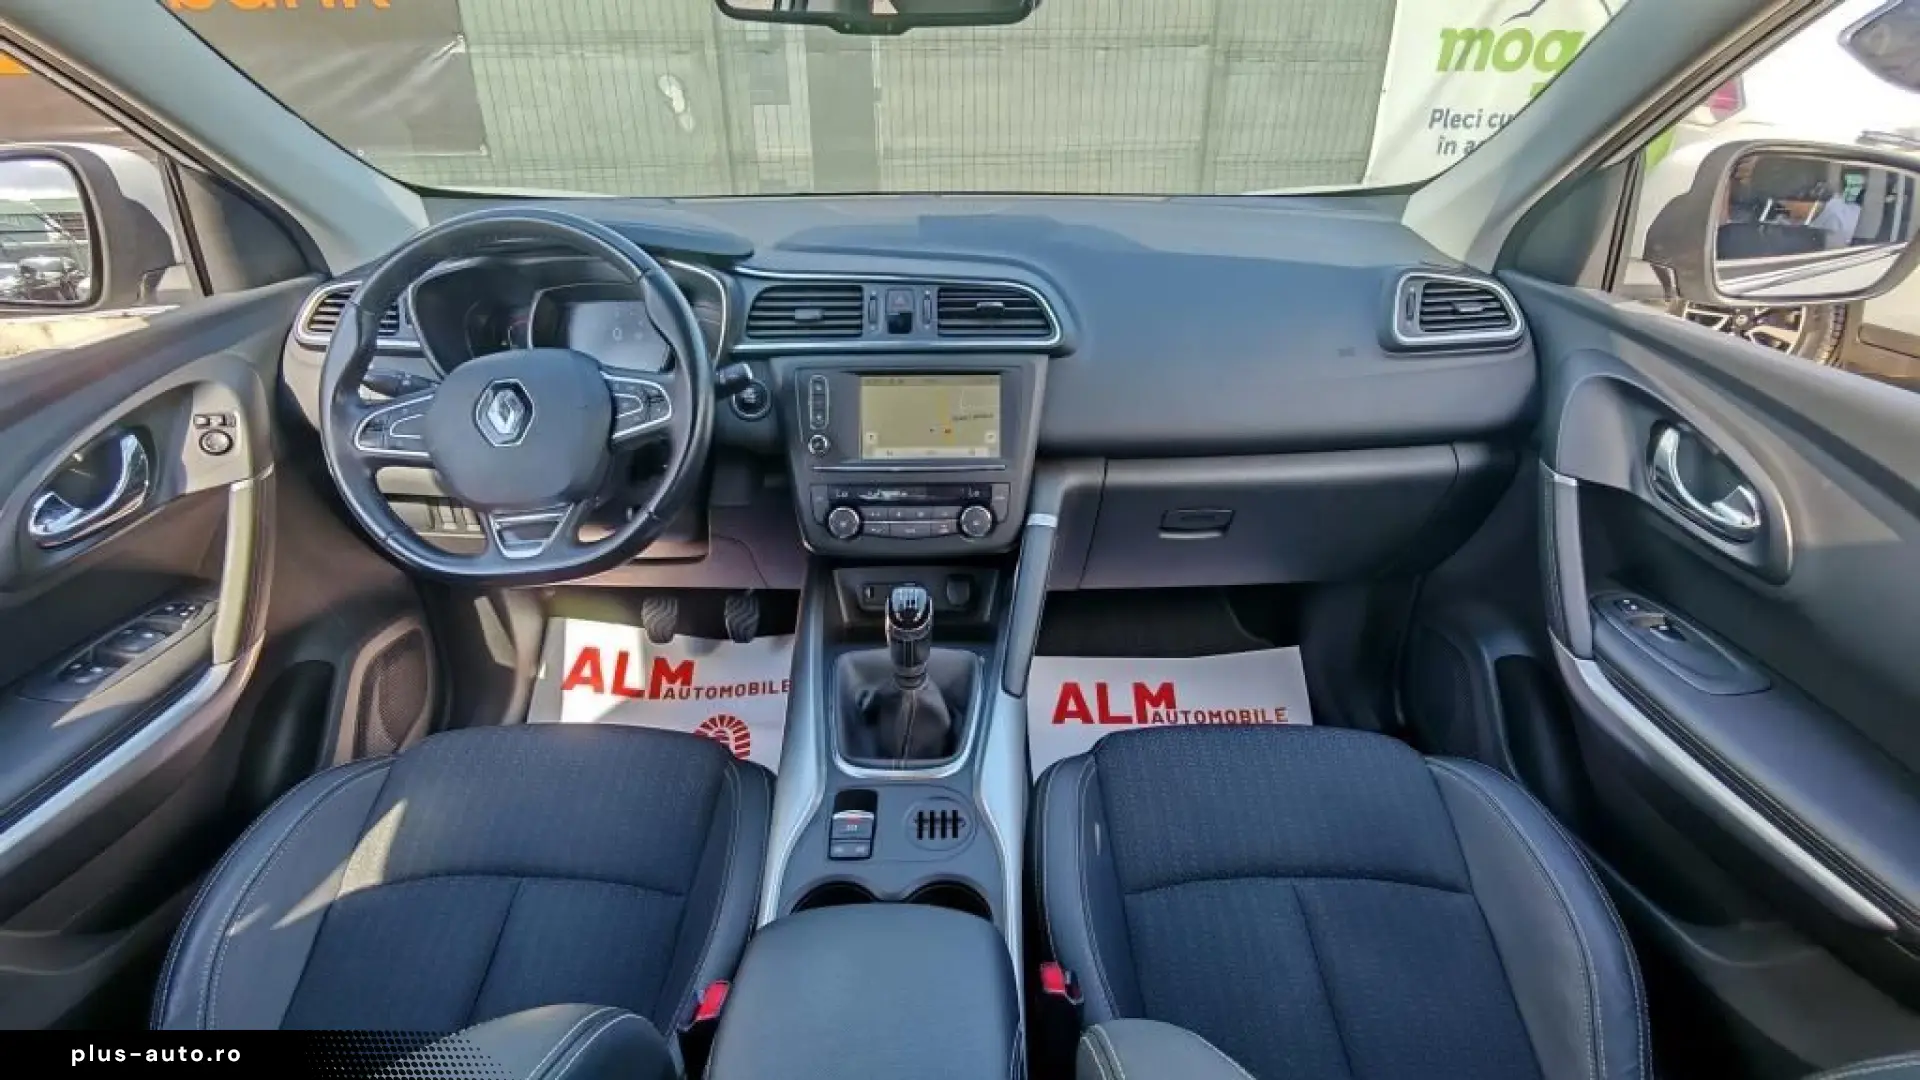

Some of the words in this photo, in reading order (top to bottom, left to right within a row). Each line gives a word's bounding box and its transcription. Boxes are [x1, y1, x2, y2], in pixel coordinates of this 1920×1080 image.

[1428, 108, 1484, 129] Pleci
[561, 646, 695, 700] ALM
[1051, 681, 1177, 725] ALM
[1151, 706, 1289, 726] AUTOMOBILE
